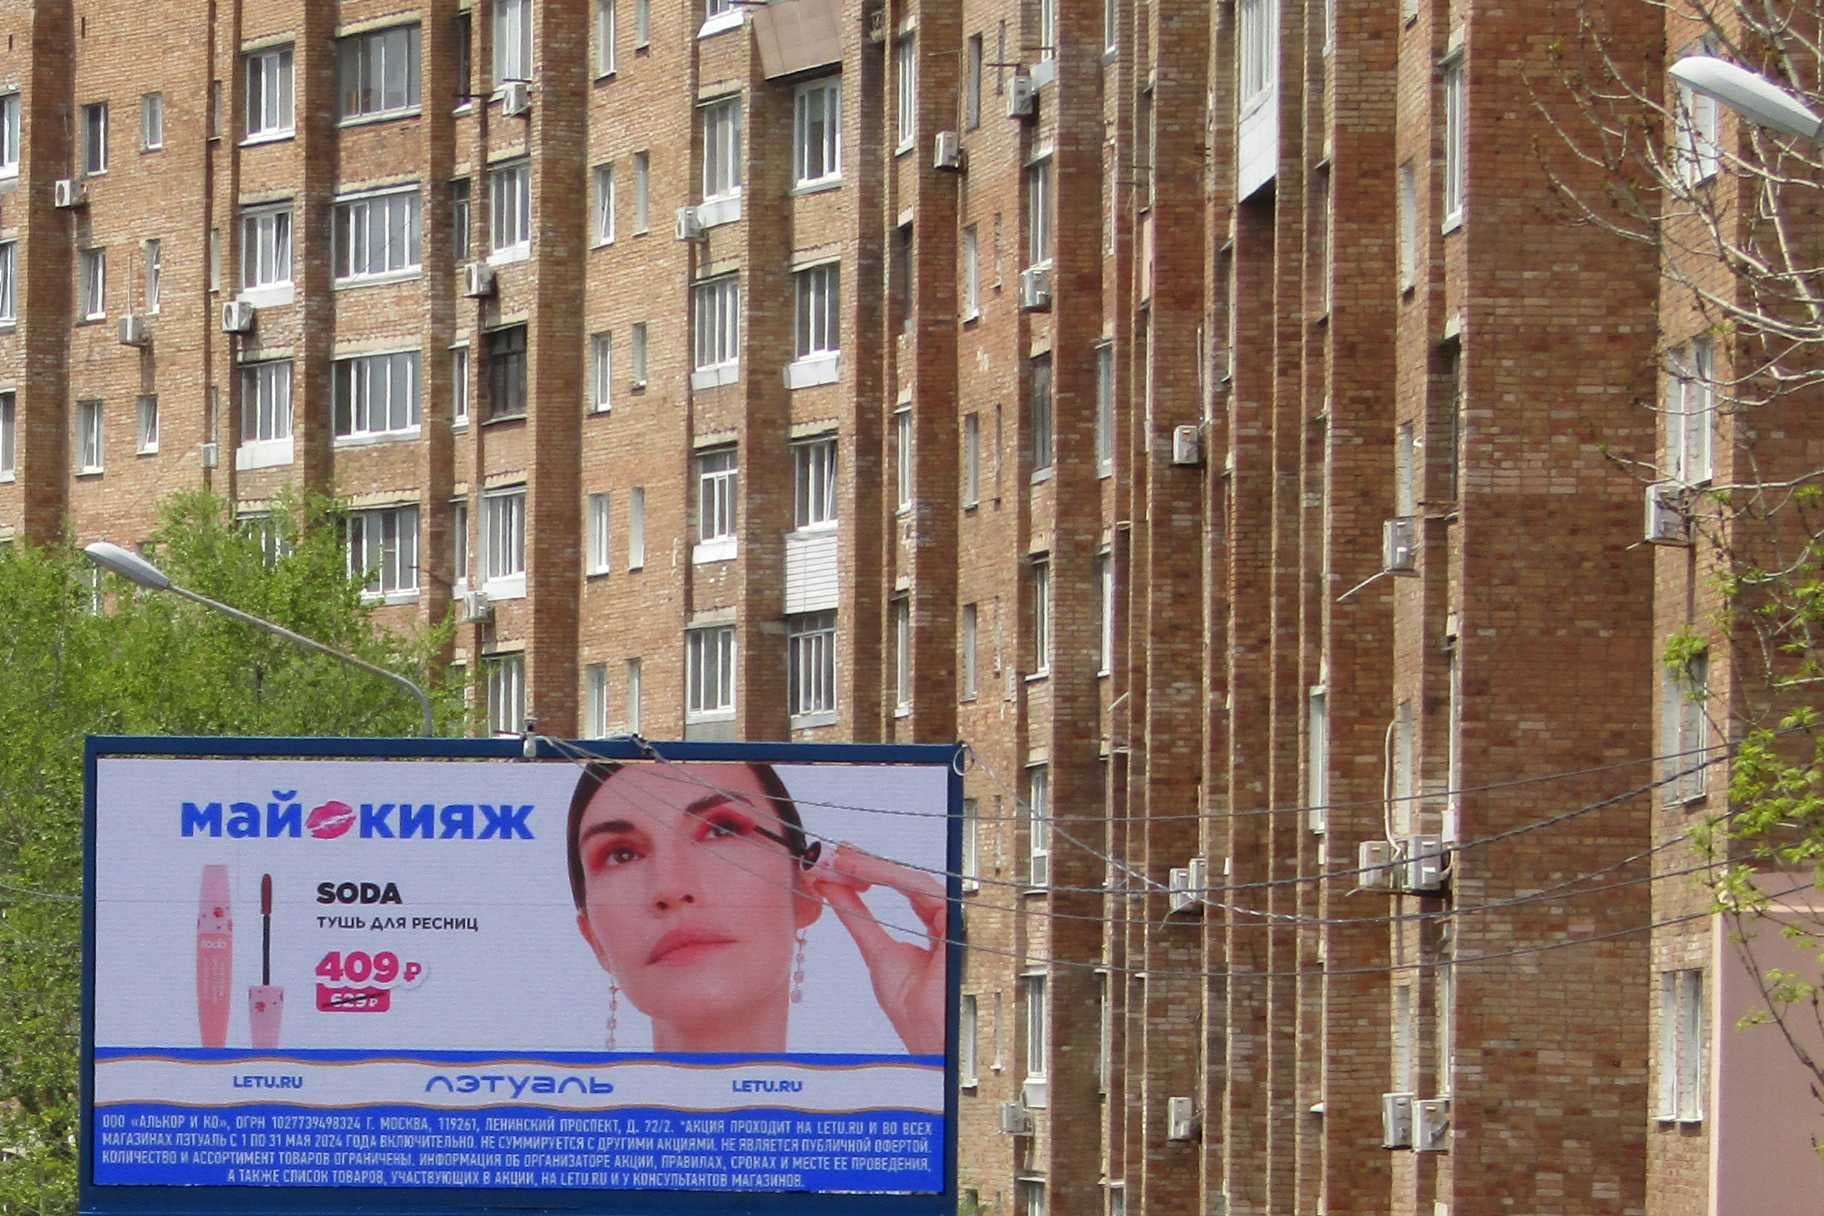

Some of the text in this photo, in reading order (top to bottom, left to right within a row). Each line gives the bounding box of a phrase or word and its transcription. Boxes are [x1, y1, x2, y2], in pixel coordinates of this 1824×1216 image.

[180, 789, 536, 840] май кияж
[315, 882, 404, 905] SODA
[316, 916, 479, 932] ТУШЬ ДЛЯ РЕСНИЦ
[233, 1075, 304, 1089] LETU.RU
[731, 1079, 804, 1093] LETU.RU
[102, 1114, 126, 1129] ООО
[236, 1116, 266, 1130] ОГРН
[380, 1117, 432, 1133] МОСКВА,
[484, 1116, 556, 1132] ЛЕНИНСКИЙ
[559, 1118, 622, 1135] ПРОСПЕКТ,
[626, 1119, 640, 1135] Д.
[729, 1120, 792, 1136] ПРОХОДИТ
[796, 1120, 812, 1135] НА
[882, 1121, 898, 1135] ВО
[902, 1121, 933, 1136] ВСЕХ
[102, 1133, 174, 1147] МАГАЗИНАХ
[175, 1133, 228, 1147] ЛЭТУАЛЬ
[250, 1134, 266, 1148] ПО
[268, 1134, 282, 1148] 31
[284, 1134, 312, 1148] МАЯ
[314, 1135, 343, 1149] 2024
[346, 1135, 377, 1151] ГОДА
[480, 1136, 496, 1150] НЕ
[498, 1136, 584, 1151] СУММИРУЕТСЯ
[598, 1137, 655, 1153] ДРУГИМИ
[721, 1138, 737, 1152] НЕ
[738, 1138, 798, 1152] ЯВЛЯЕТСЯ
[801, 1137, 872, 1153] ПУБЛИЧНОЙ
[102, 1150, 178, 1165] КОЛИЧЕСТВО
[192, 1151, 275, 1166] АССОРТИМЕНТ
[278, 1152, 330, 1166] ТОВАРОВ
[418, 1153, 502, 1170] ИНФОРМАЦИЯ
[505, 1154, 520, 1168] ОБ
[524, 1154, 611, 1169] ОРГАНИЗАТОРЕ
[661, 1155, 727, 1172] ПРАВИЛАХ,
[730, 1156, 777, 1170] СРОКАХ
[792, 1156, 830, 1170] МЕСТЕ
[834, 1157, 848, 1171] ЕЕ
[239, 1169, 280, 1183] ТАКЖЕ
[282, 1170, 328, 1183] СПИСОК
[390, 1171, 480, 1187] УЧАСТВУЮЩИХ
[540, 1172, 558, 1185] НА
[632, 1173, 727, 1187] КОНСУЛЬТАНТОВ
